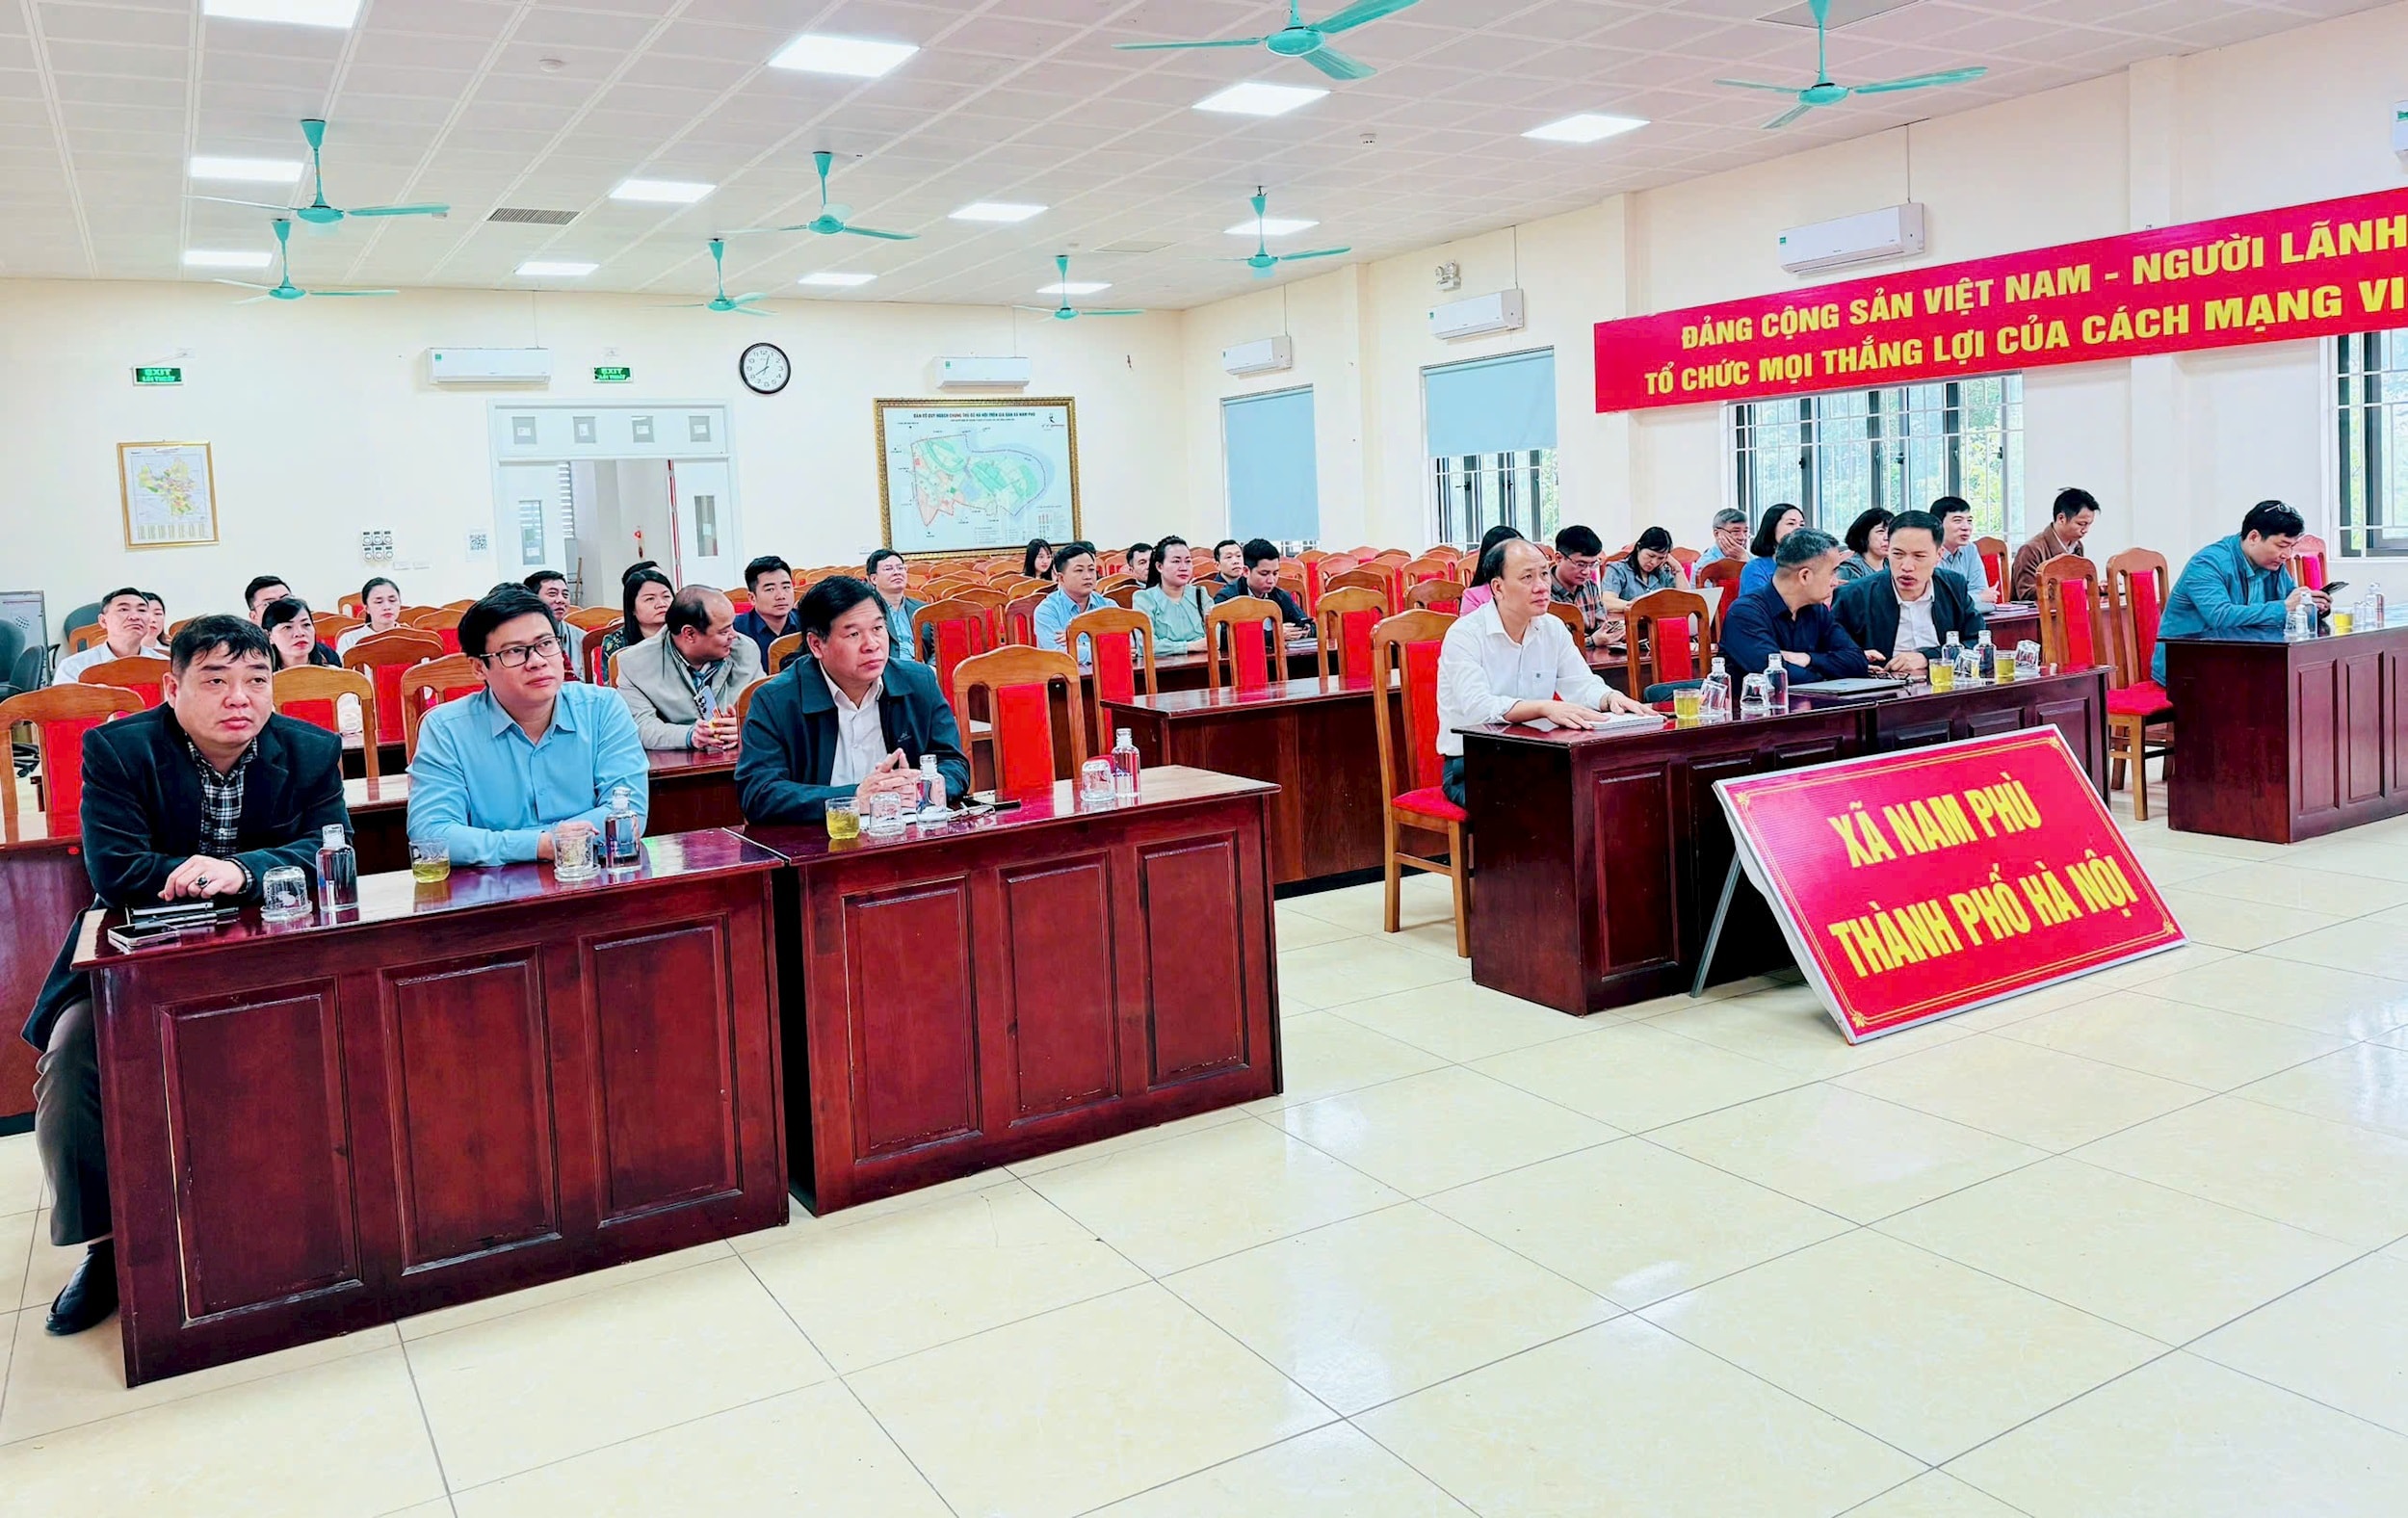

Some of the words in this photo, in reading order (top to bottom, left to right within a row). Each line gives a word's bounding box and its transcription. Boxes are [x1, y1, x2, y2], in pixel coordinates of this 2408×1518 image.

[1644, 361, 1674, 396] TỔ
[1681, 358, 1749, 392] CHỨC
[1759, 353, 1813, 384] MỌI
[1821, 335, 1923, 374] THẮNG
[1933, 328, 1984, 365] LỢI
[1996, 314, 2070, 353] CỦA
[2081, 303, 2189, 345] CÁCH
[2204, 285, 2342, 332] MẠNG
[1681, 315, 1753, 350] ĐẢNG
[1762, 305, 1840, 339] CỘNG
[1849, 287, 1913, 325] SẢN
[1924, 277, 1994, 315] VIỆT
[2005, 264, 2091, 303] NAM
[2105, 272, 2119, 281] -
[2133, 232, 2264, 285] NGƯỜI
[2280, 219, 2407, 264] LÃNH
[1827, 800, 1897, 869] XÃ
[1882, 793, 1978, 856] NAM
[1964, 772, 2043, 838] PHÙ
[1827, 902, 1962, 979] THÀNH
[1948, 862, 2030, 947] PHỐ
[2021, 861, 2082, 928] HÀ
[2074, 849, 2139, 919] NỘI
